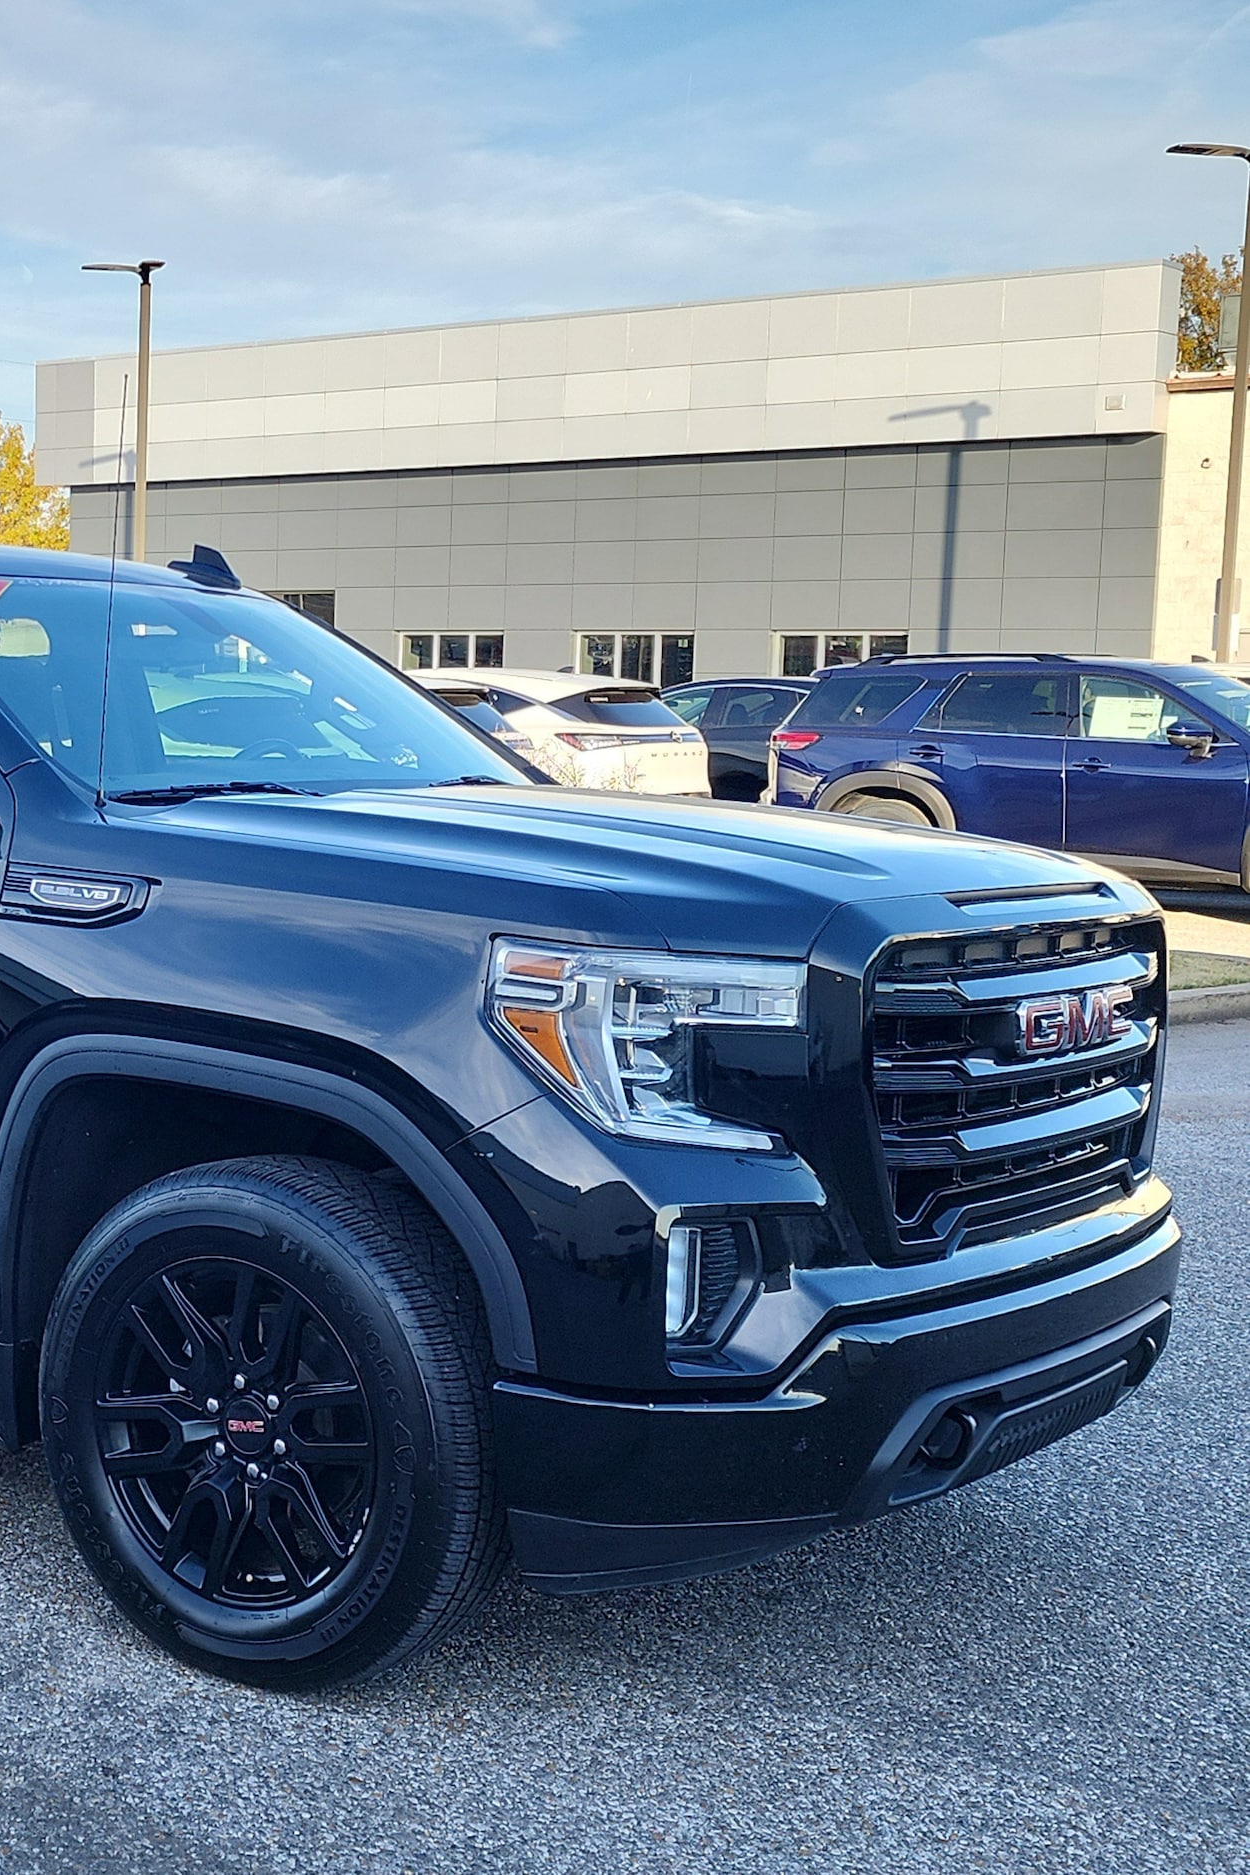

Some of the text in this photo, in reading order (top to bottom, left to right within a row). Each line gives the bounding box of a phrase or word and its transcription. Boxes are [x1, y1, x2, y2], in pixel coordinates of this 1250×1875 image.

[1016, 984, 1134, 1057] GMC
[227, 1419, 265, 1434] GMC
[338, 1503, 408, 1630] DESTINATION
